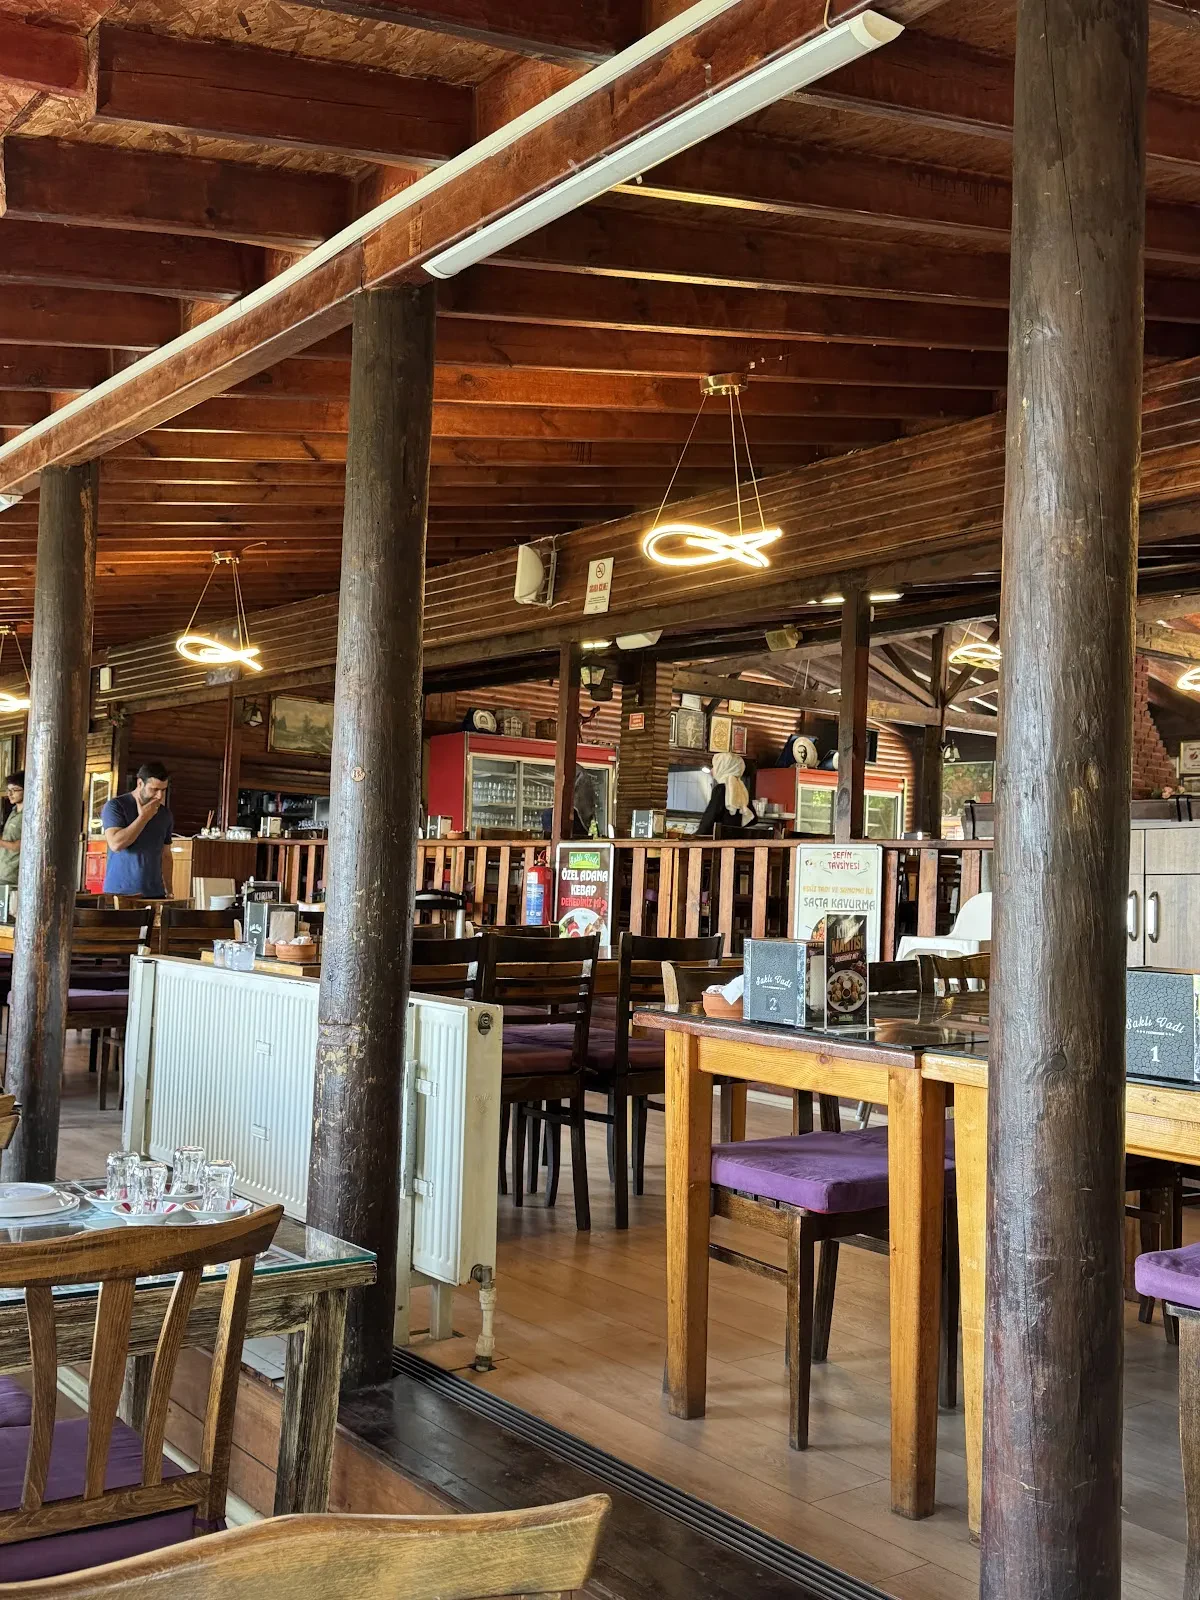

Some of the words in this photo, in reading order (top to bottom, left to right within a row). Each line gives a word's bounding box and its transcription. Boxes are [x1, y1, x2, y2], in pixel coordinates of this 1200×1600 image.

[832, 850, 853, 860] ŞEFİN
[828, 860, 860, 870] TAVSİYESİ
[561, 867, 580, 881] ÖZEL
[580, 870, 608, 882] ADANA
[571, 884, 597, 896] KEBAP
[804, 897, 829, 909] SAÇTA
[831, 898, 875, 911] KAVURMA
[769, 997, 777, 1011] 2
[1126, 1016, 1153, 1030] Saklı
[1150, 1045, 1160, 1062] 1
